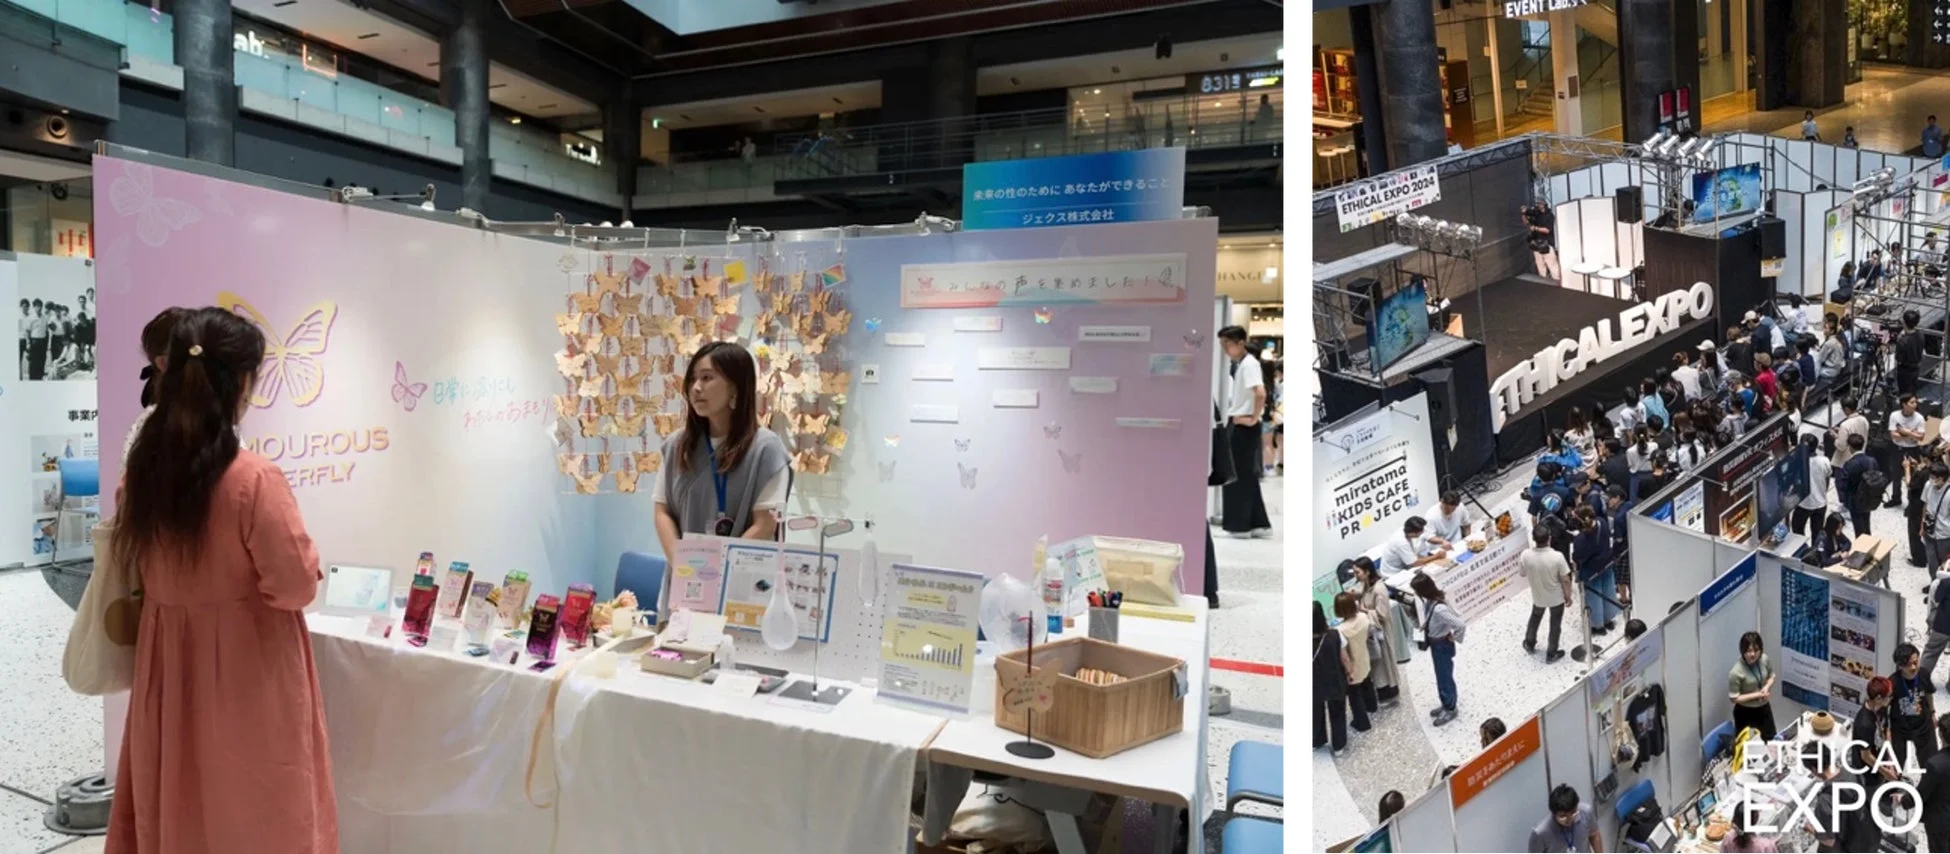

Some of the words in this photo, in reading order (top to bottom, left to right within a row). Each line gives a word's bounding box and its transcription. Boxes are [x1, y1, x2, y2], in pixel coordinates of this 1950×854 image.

[1505, 0, 1543, 18] EVENT
[973, 184, 1061, 201] 未来の性のために
[1064, 178, 1171, 195] あなたができること
[1341, 194, 1382, 214] ETHICAL
[1384, 185, 1410, 201] EXPO
[1412, 176, 1436, 192] 2024
[1022, 208, 1115, 224] ジェクス株式会社
[1335, 465, 1408, 507] miratama
[1338, 497, 1373, 524] KIDS
[1375, 478, 1410, 504] CAFE
